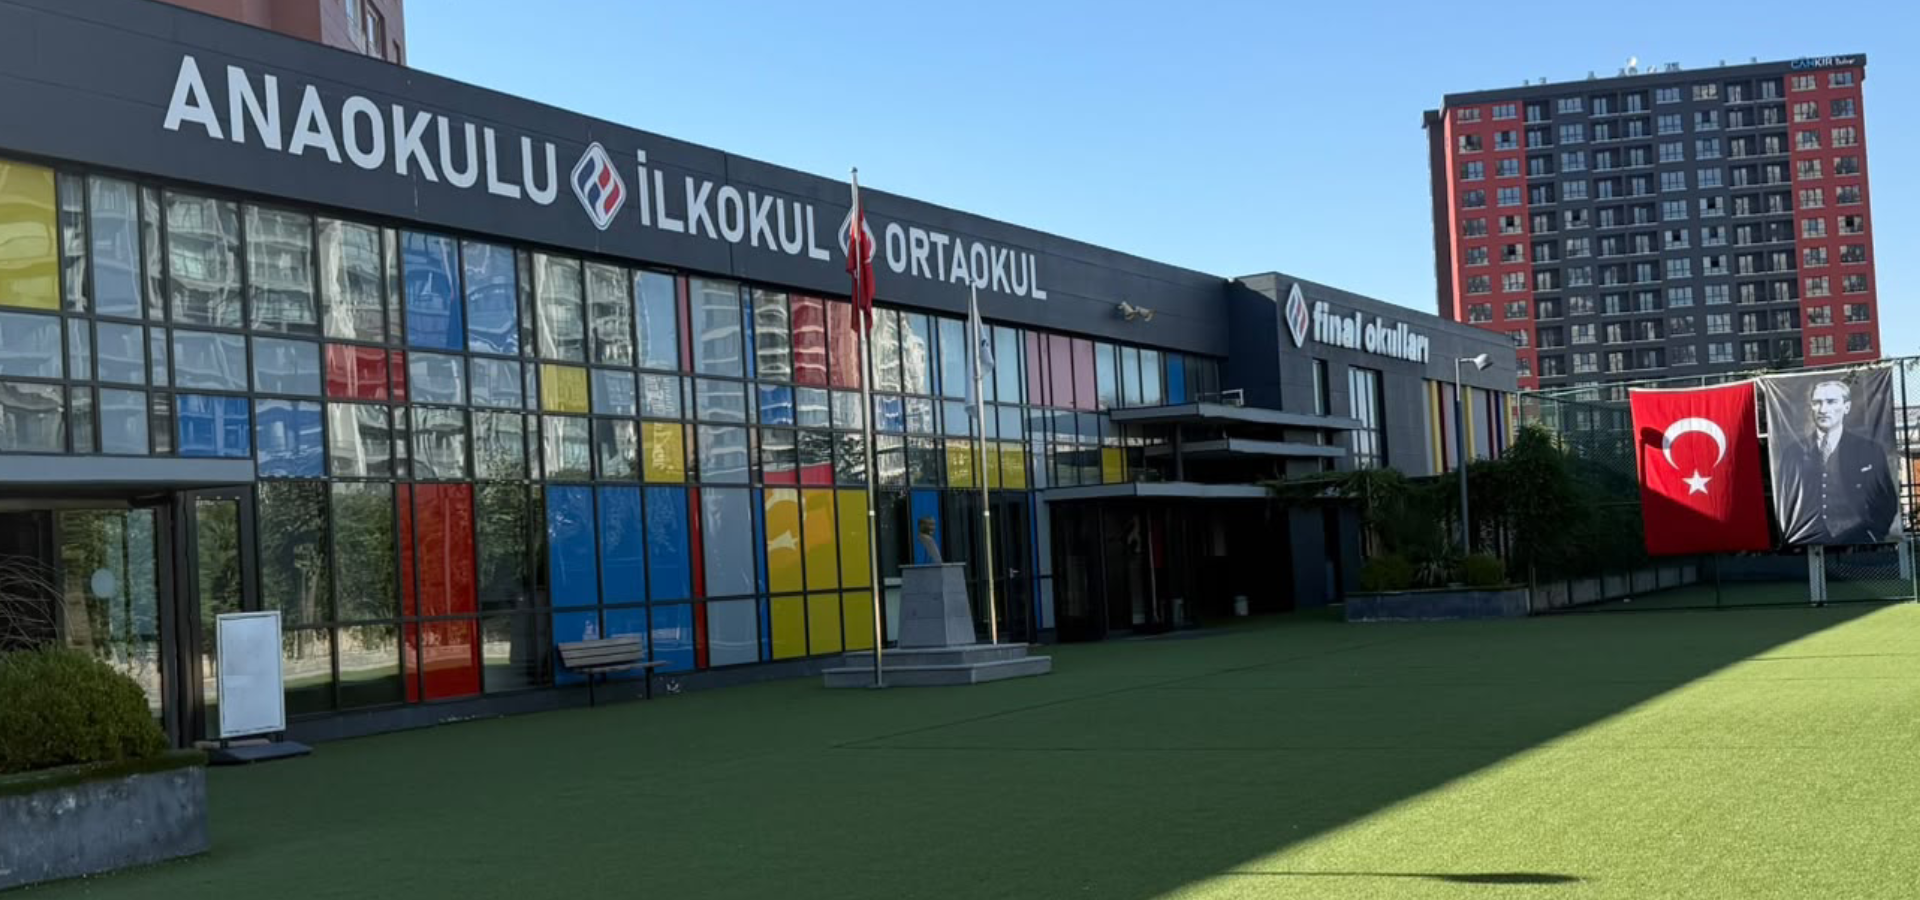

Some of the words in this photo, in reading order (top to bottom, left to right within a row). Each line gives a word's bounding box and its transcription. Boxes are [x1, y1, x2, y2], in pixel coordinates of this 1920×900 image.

[163, 55, 558, 205] ANAOKULU
[637, 149, 830, 261] İLKOKUL
[885, 222, 1047, 300] ORTAOKUL
[1312, 300, 1362, 350] final
[1364, 316, 1430, 364] okulları
